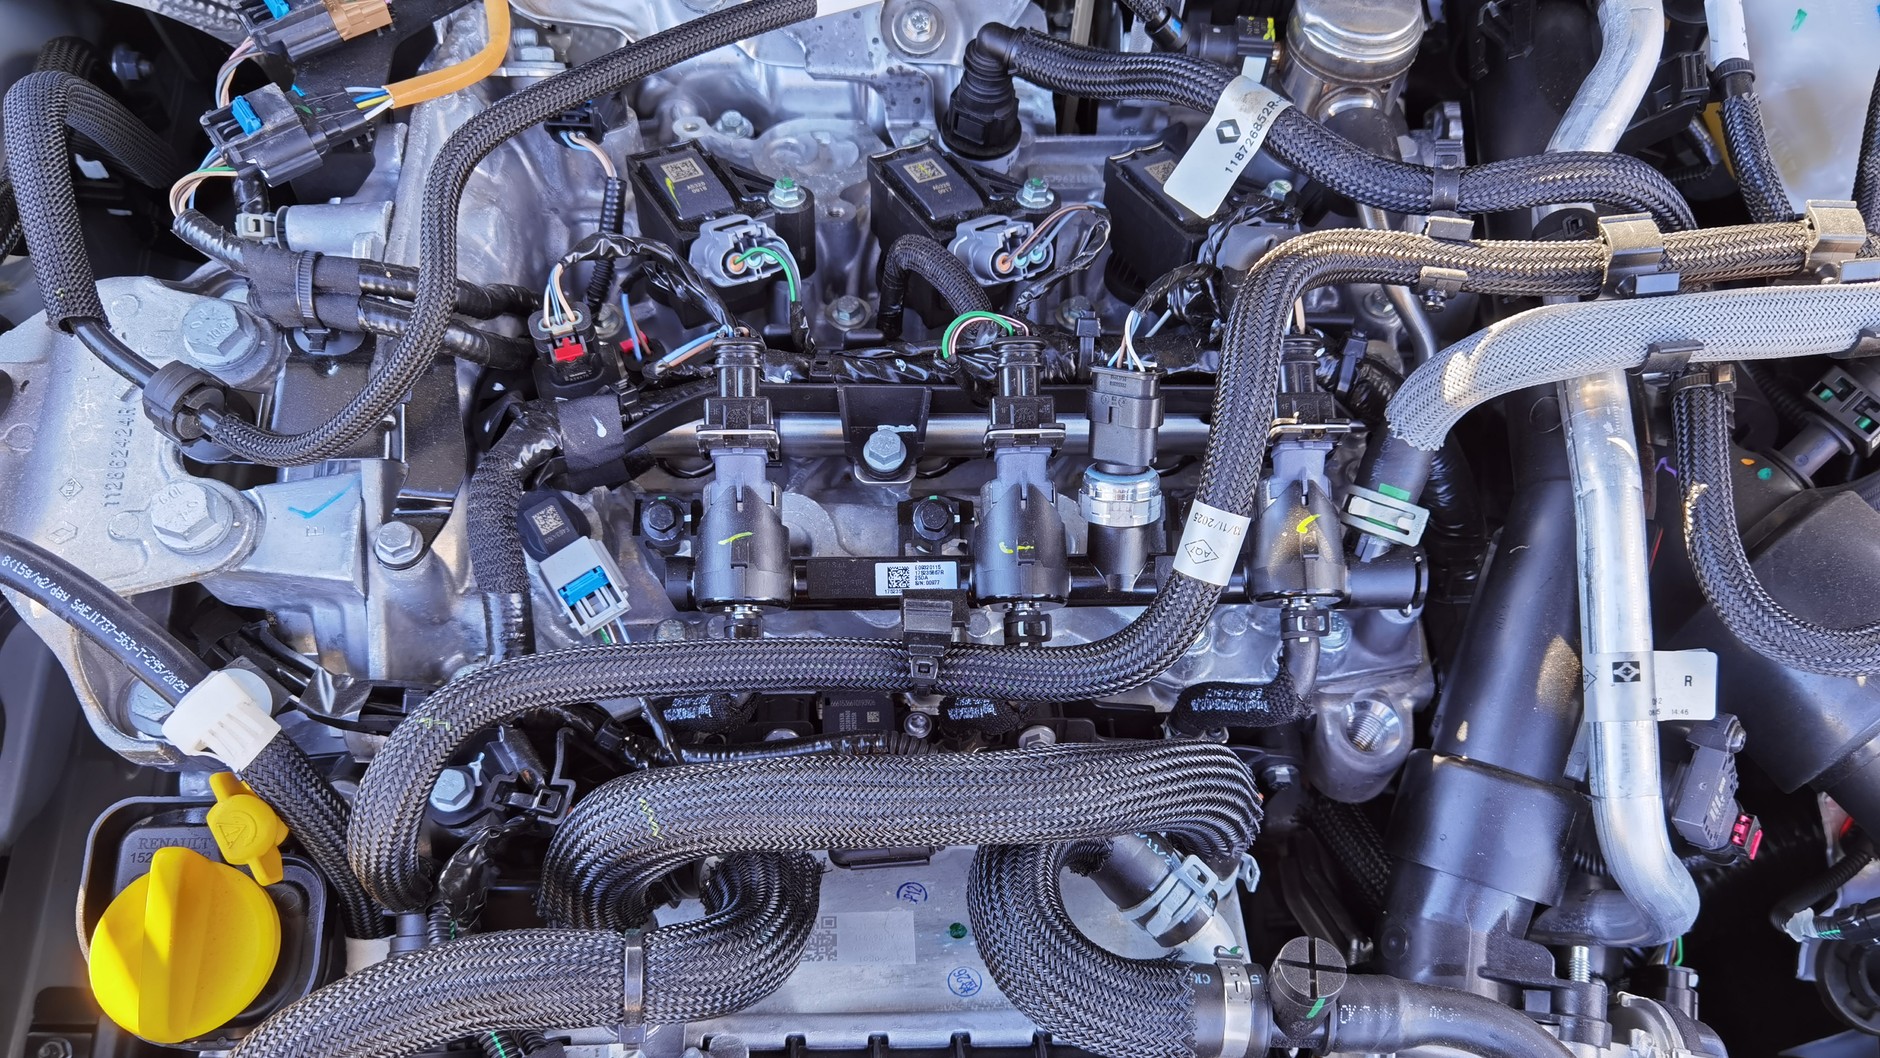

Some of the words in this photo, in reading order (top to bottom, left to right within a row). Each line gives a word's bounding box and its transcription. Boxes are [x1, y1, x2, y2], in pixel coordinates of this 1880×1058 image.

[1193, 512, 1242, 536] 13/11/2025
[1684, 675, 1693, 687] R
[138, 837, 213, 850] RENAULT
